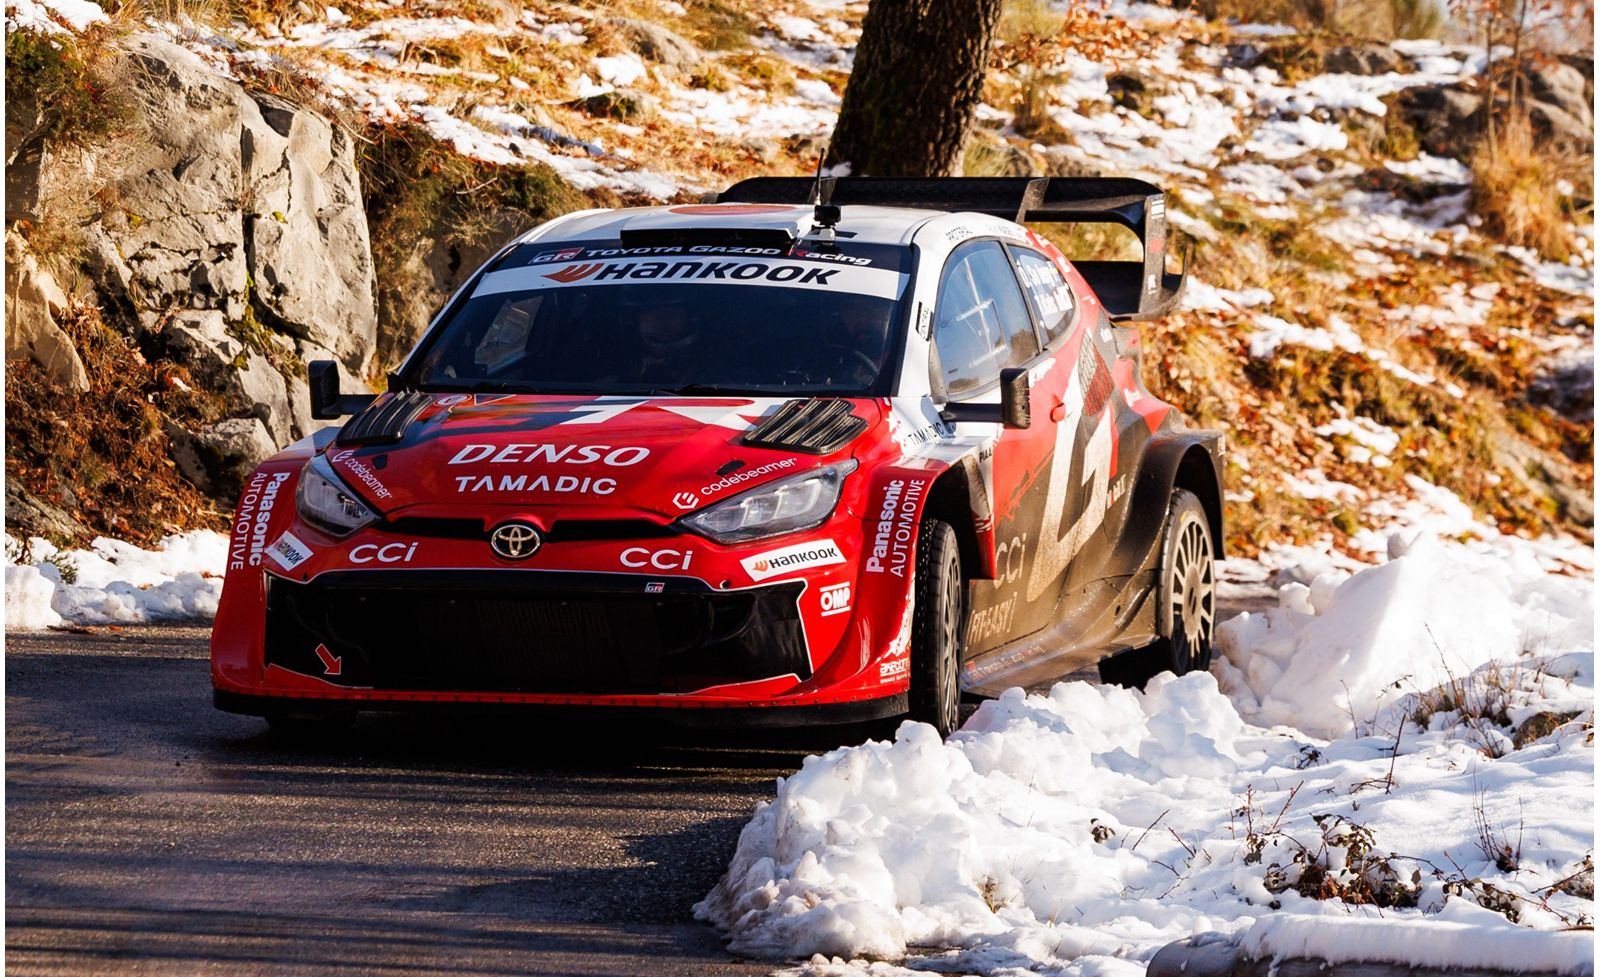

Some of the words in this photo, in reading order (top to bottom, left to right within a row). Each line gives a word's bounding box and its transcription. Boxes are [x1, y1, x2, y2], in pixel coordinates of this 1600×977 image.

[533, 250, 576, 262] GR
[586, 246, 682, 257] TOYOTA
[689, 245, 781, 256] GAZOO
[786, 249, 873, 266] Racing
[448, 444, 651, 467] DENSO
[345, 459, 392, 499] codebeamer
[455, 475, 618, 495] TAMADIC
[701, 458, 797, 496] codebeamer
[230, 472, 268, 570] AUTOMOTIVE
[249, 472, 291, 567] Panasonic
[866, 479, 905, 574] Panasonic
[890, 479, 926, 578] AUTOMOTIVE
[646, 583, 664, 593] GR
[820, 588, 851, 611] OMP
